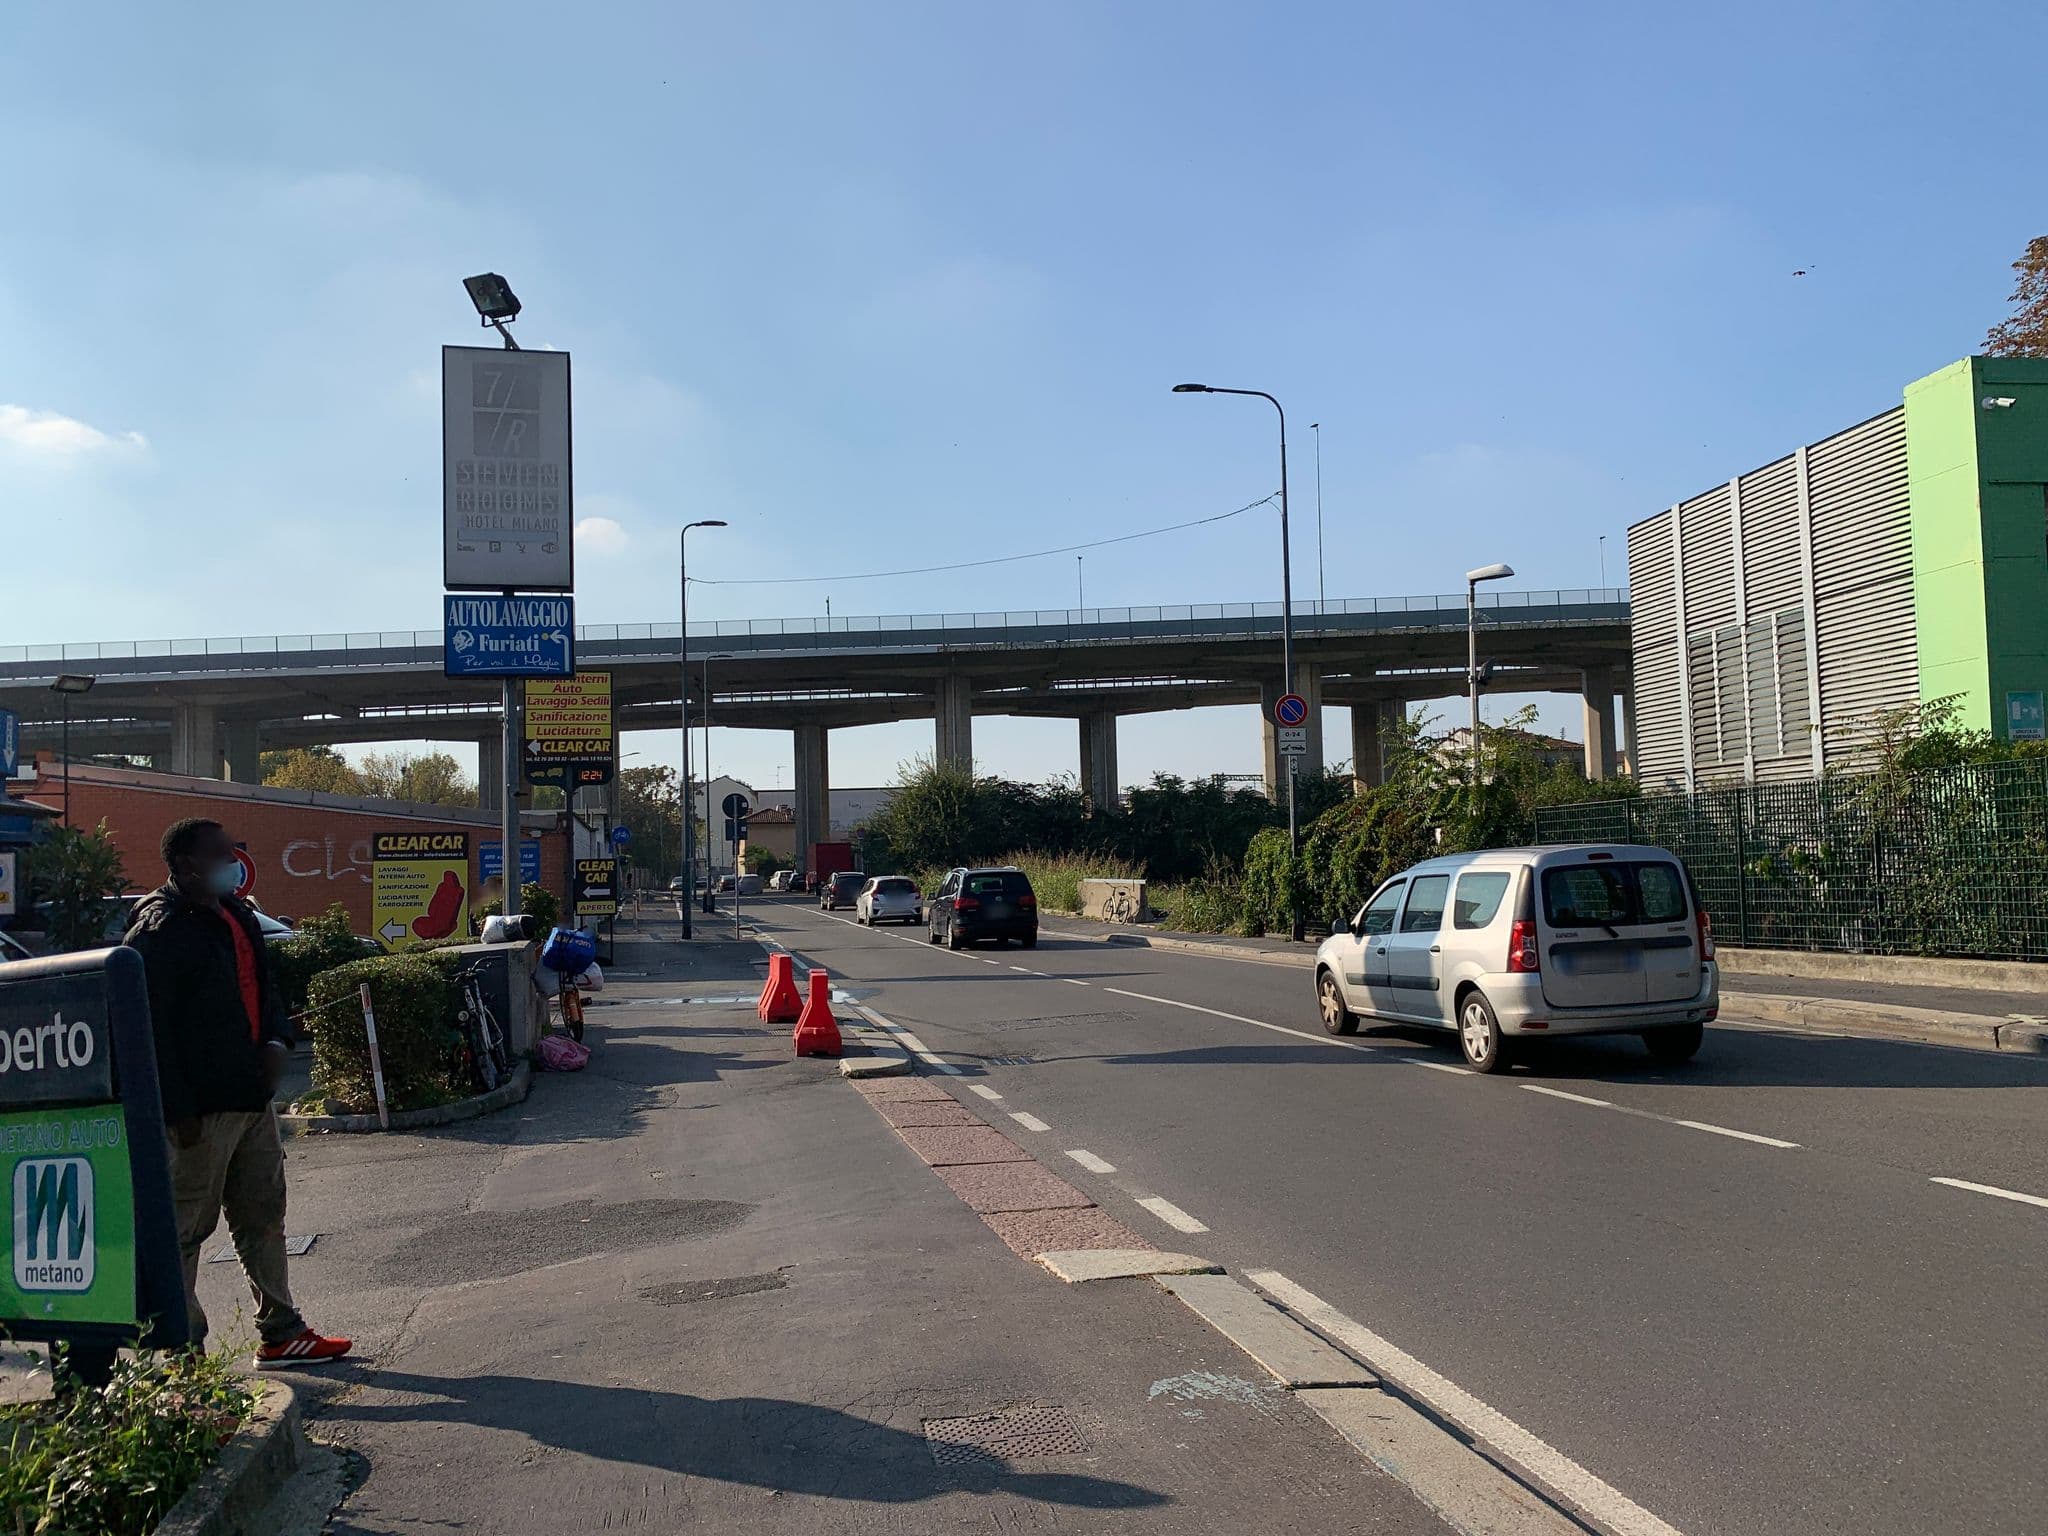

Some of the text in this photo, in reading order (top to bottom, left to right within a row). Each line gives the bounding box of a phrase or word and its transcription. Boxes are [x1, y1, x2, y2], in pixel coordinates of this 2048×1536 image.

[460, 490, 556, 511] ROOMS
[466, 516, 559, 531] HOTEL MILANO
[448, 600, 569, 628] AUTOLAVAGGIO
[479, 634, 540, 652] Furiati
[460, 655, 482, 667] Per
[524, 654, 560, 671] Meglio
[570, 674, 609, 684] nterni
[552, 684, 582, 693] Auto
[527, 696, 610, 708] Lavaggio Sedili
[530, 711, 608, 721] Sanificazione
[536, 726, 602, 736] Lucidature
[542, 740, 611, 753] CLEAR CAR
[378, 835, 464, 851] CLEAR CAR
[578, 861, 615, 871] CLEAR
[586, 872, 608, 883] CAR
[69, 1117, 121, 1147] AUTO
[25, 1264, 83, 1283] metano
